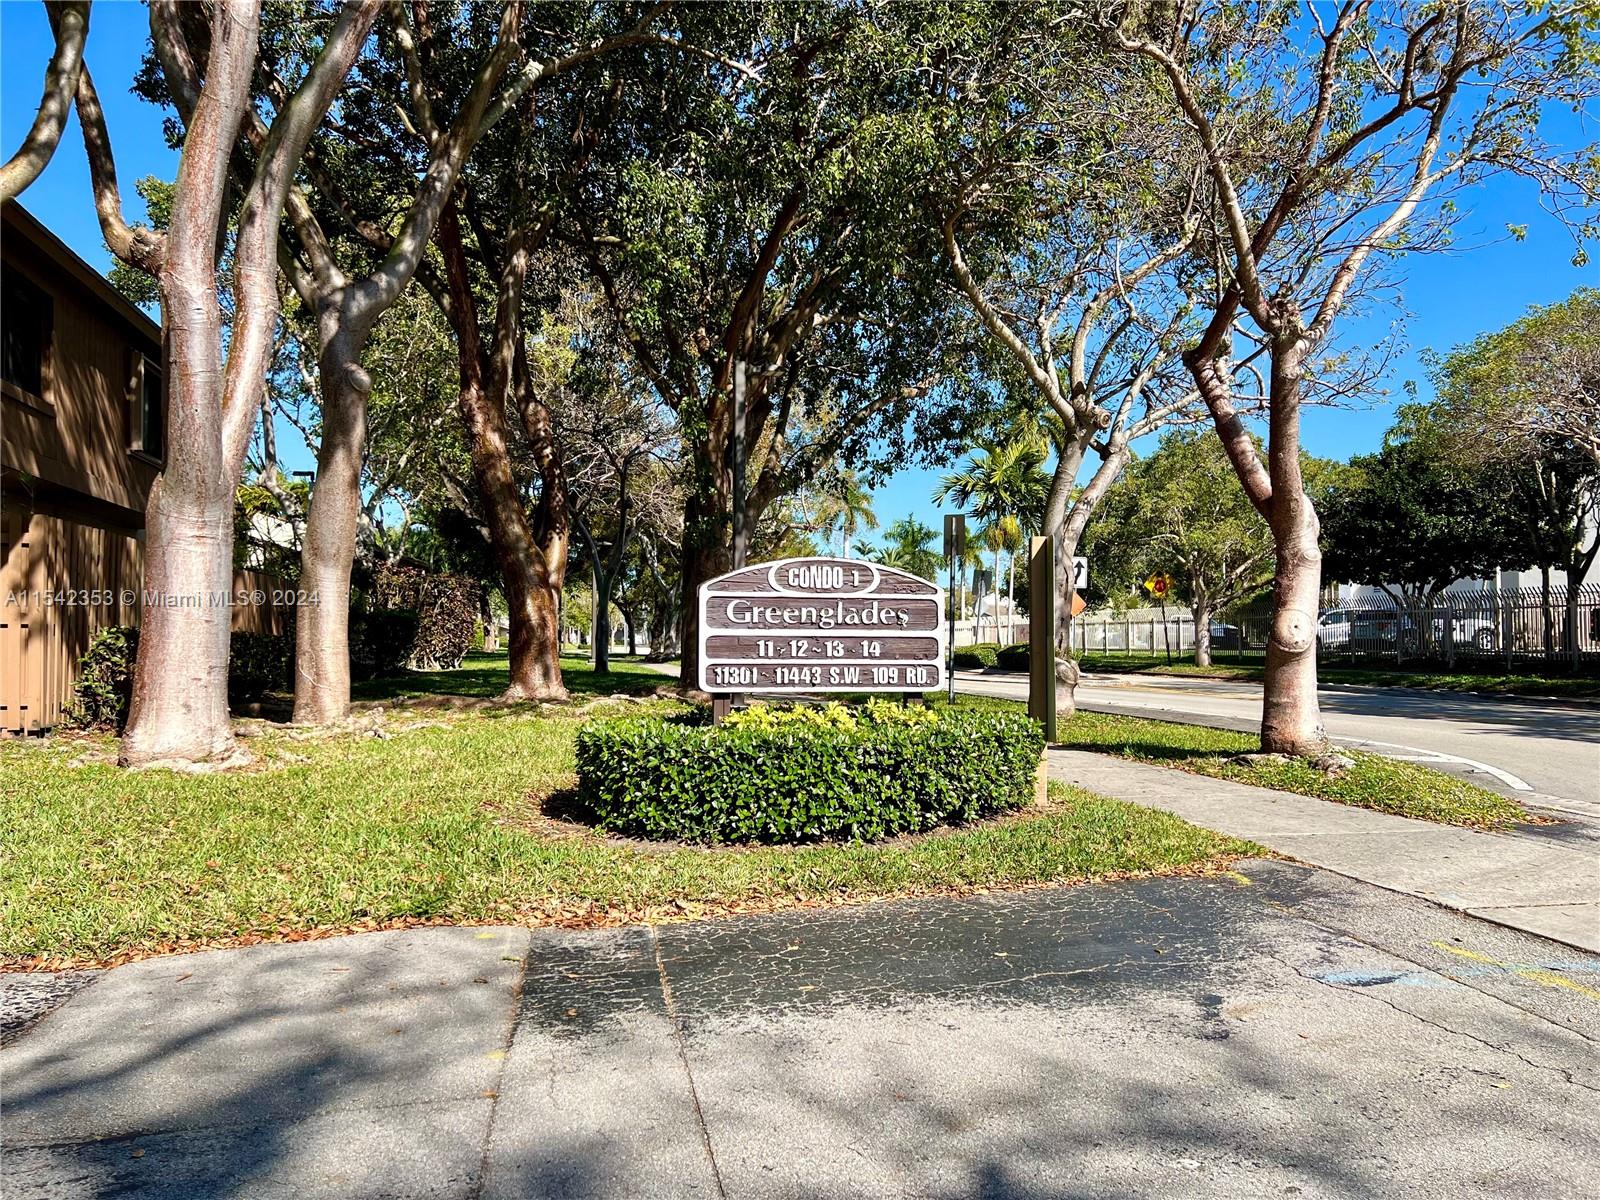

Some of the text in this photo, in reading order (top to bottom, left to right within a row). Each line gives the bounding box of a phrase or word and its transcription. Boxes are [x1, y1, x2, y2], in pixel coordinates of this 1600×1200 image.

[788, 565, 860, 589] CONDO 1
[726, 600, 909, 629] Greenglades
[757, 640, 774, 657] 11
[789, 640, 809, 657] 12
[824, 640, 845, 657] 13
[860, 640, 881, 657] 14
[714, 666, 758, 685] 11301
[775, 666, 822, 685] 11443
[829, 666, 863, 684] S.W.
[872, 667, 899, 685] 109
[906, 666, 931, 684] RD.
